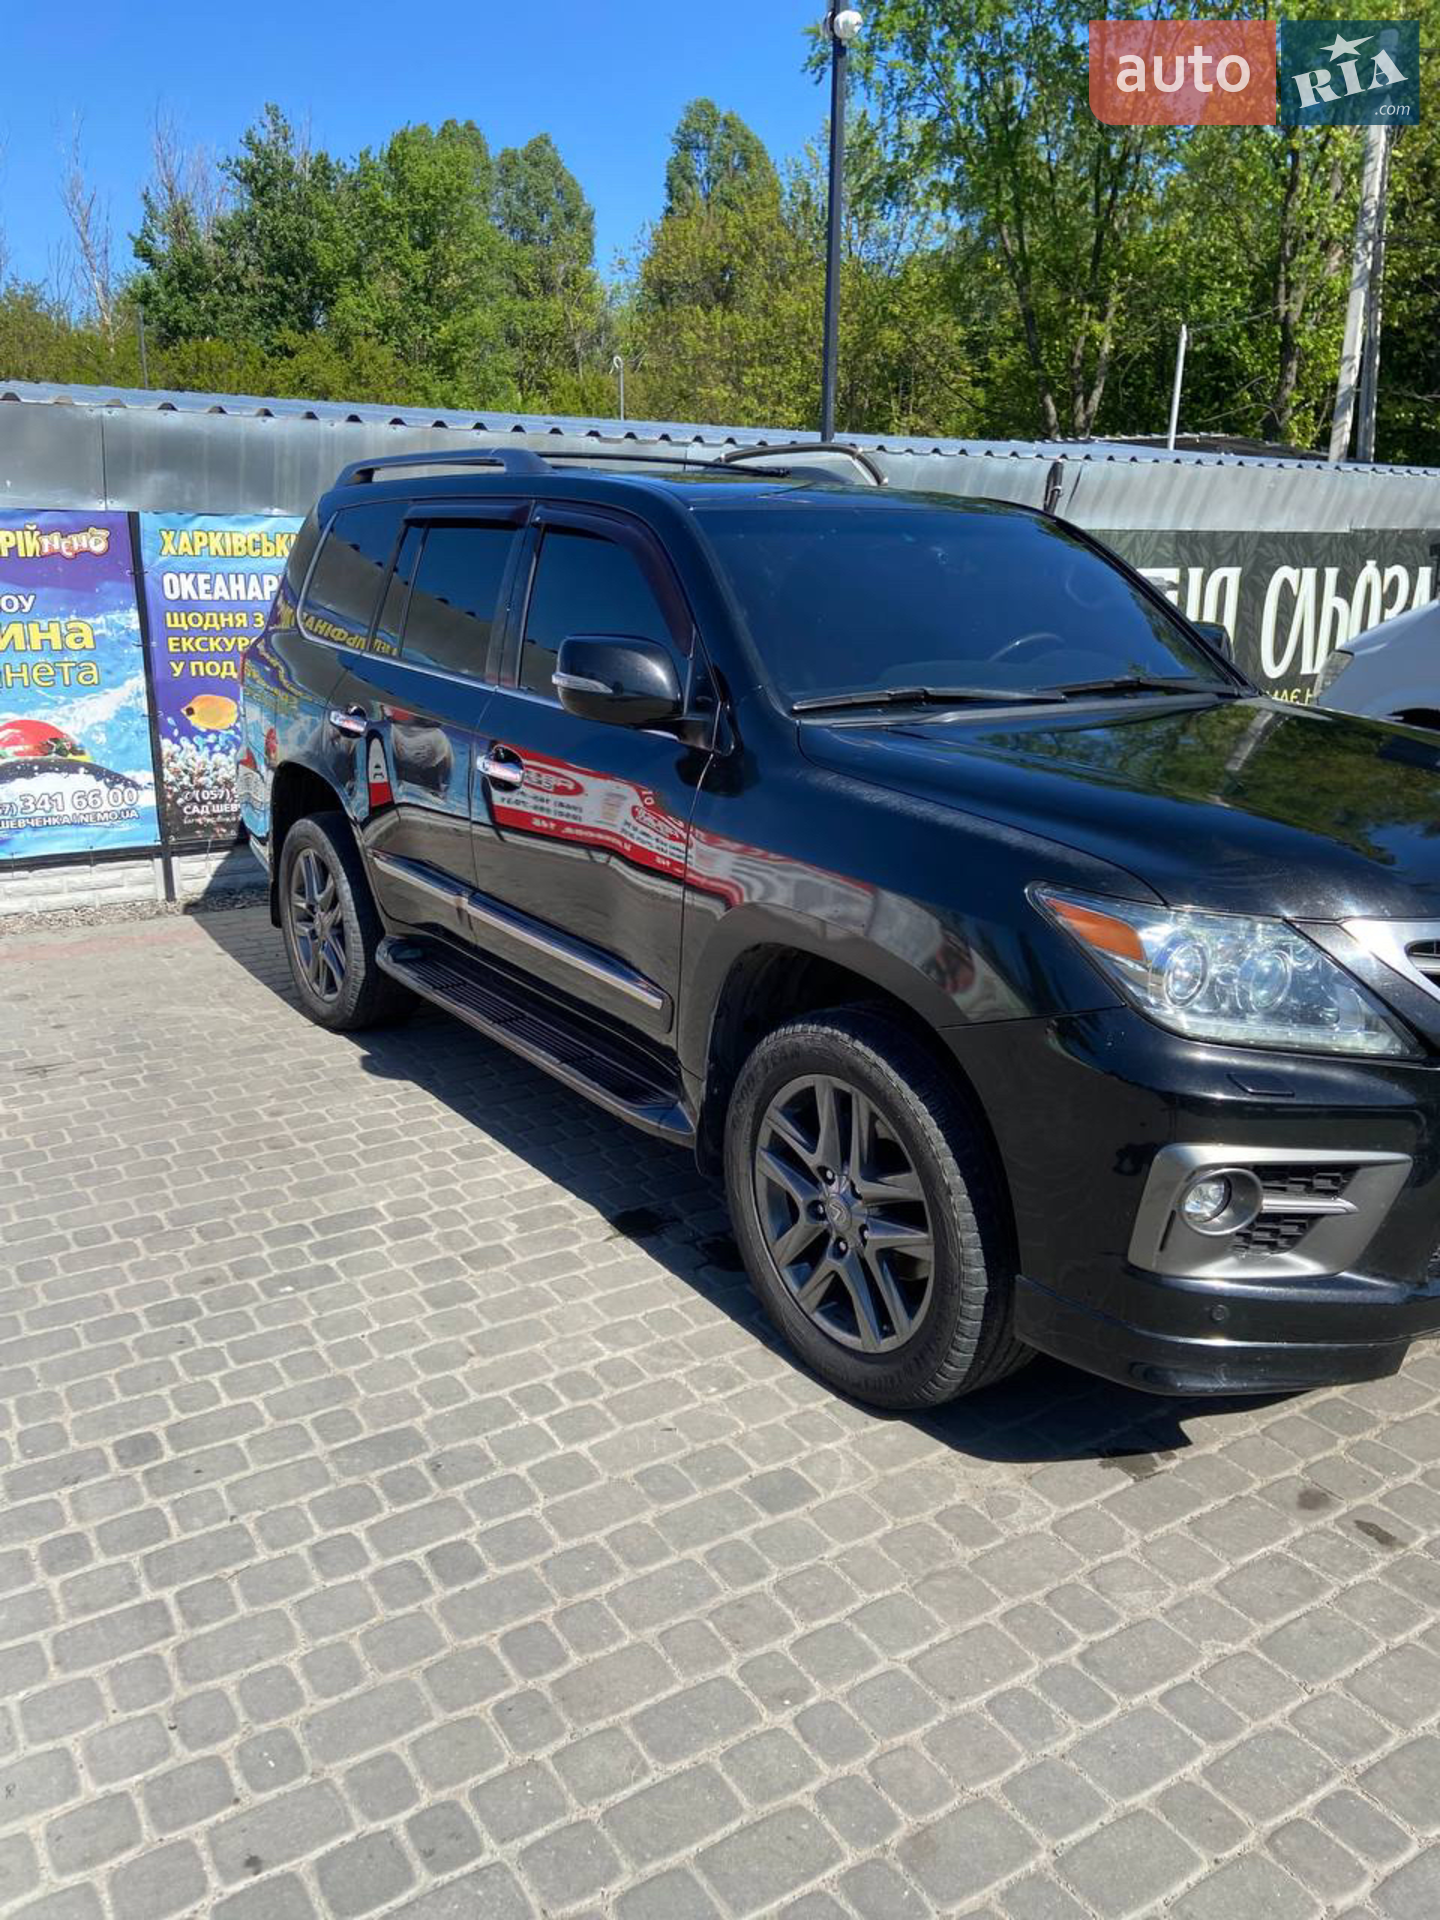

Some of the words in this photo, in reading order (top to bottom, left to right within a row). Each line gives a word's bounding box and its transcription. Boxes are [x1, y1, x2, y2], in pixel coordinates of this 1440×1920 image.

[160, 530, 299, 558] ХАРКІВСЬК
[162, 573, 282, 601] ОКЕАНАР
[0, 594, 36, 613] ОУ
[166, 611, 248, 631] ЩОДНЯ
[0, 661, 100, 689] нета
[170, 660, 185, 678] У
[19, 792, 65, 815] 341
[72, 789, 103, 811] 66
[108, 787, 139, 807] 00
[183, 804, 211, 815] САД
[212, 802, 240, 813] ШЕВ
